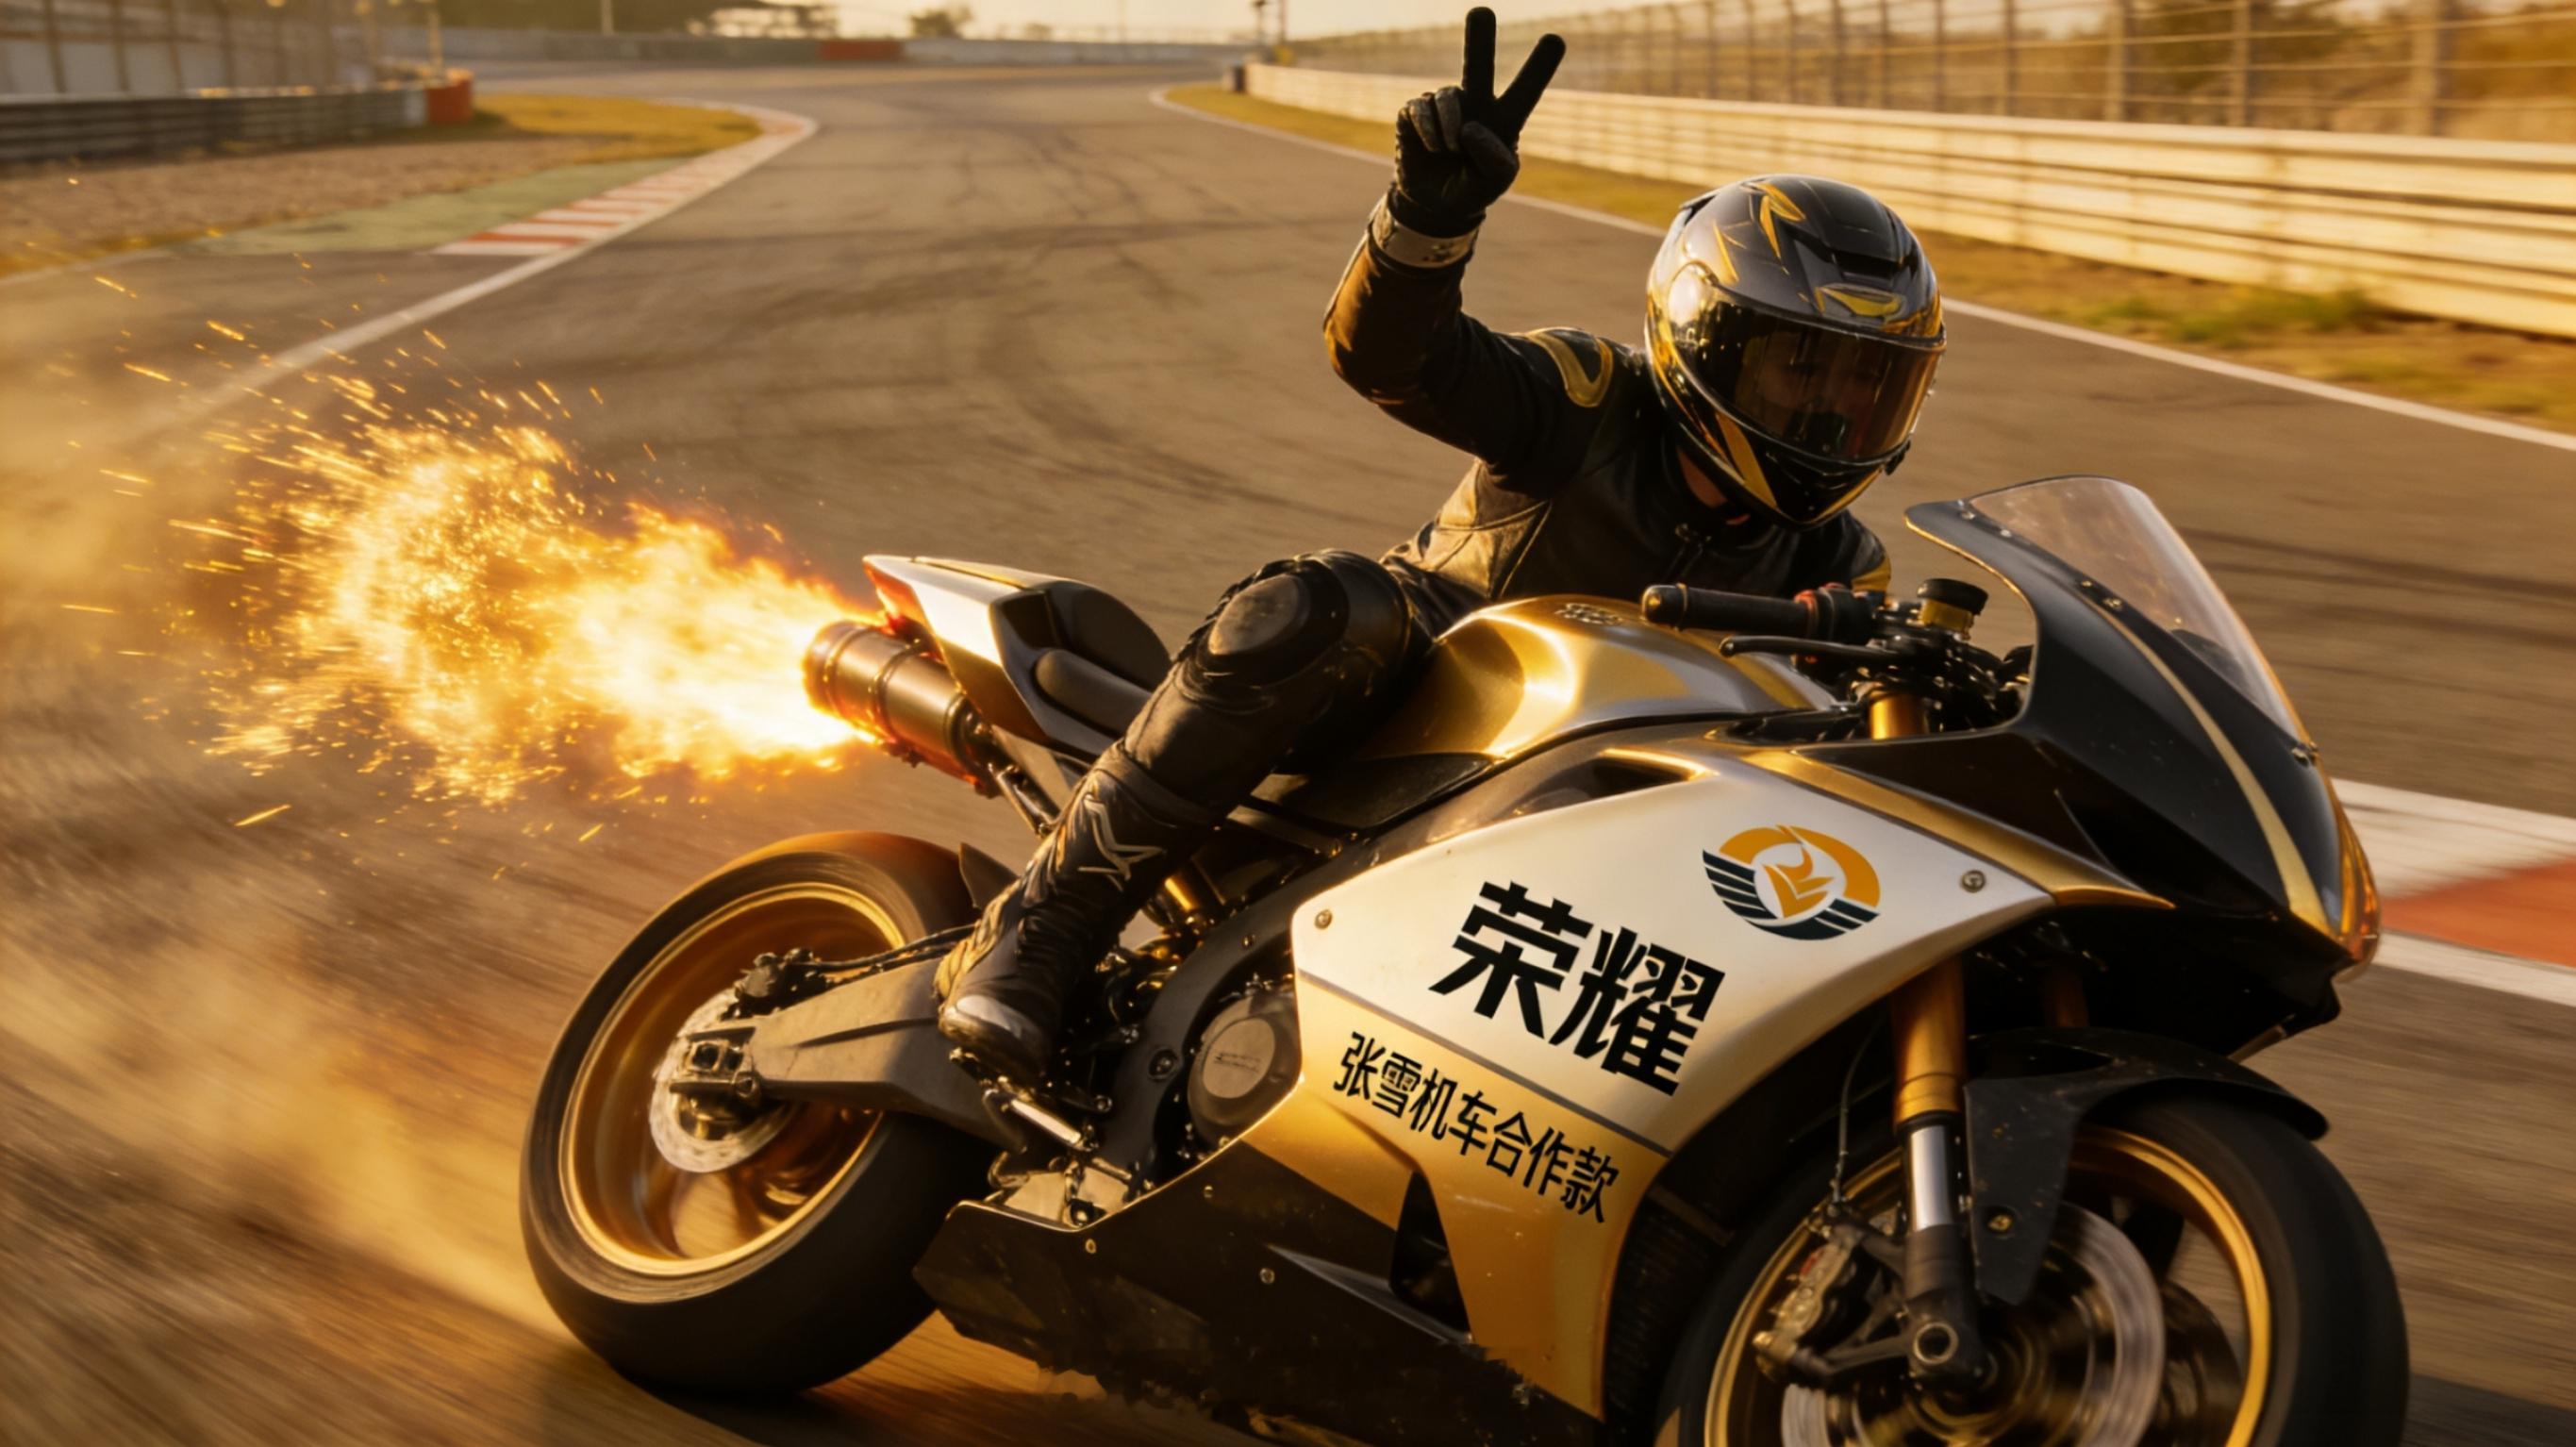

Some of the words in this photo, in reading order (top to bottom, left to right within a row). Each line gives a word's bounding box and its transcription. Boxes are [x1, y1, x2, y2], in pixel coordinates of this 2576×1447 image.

[1429, 881, 1725, 1096] 荣耀
[1334, 1032, 1620, 1223] 张雪机车合作款
